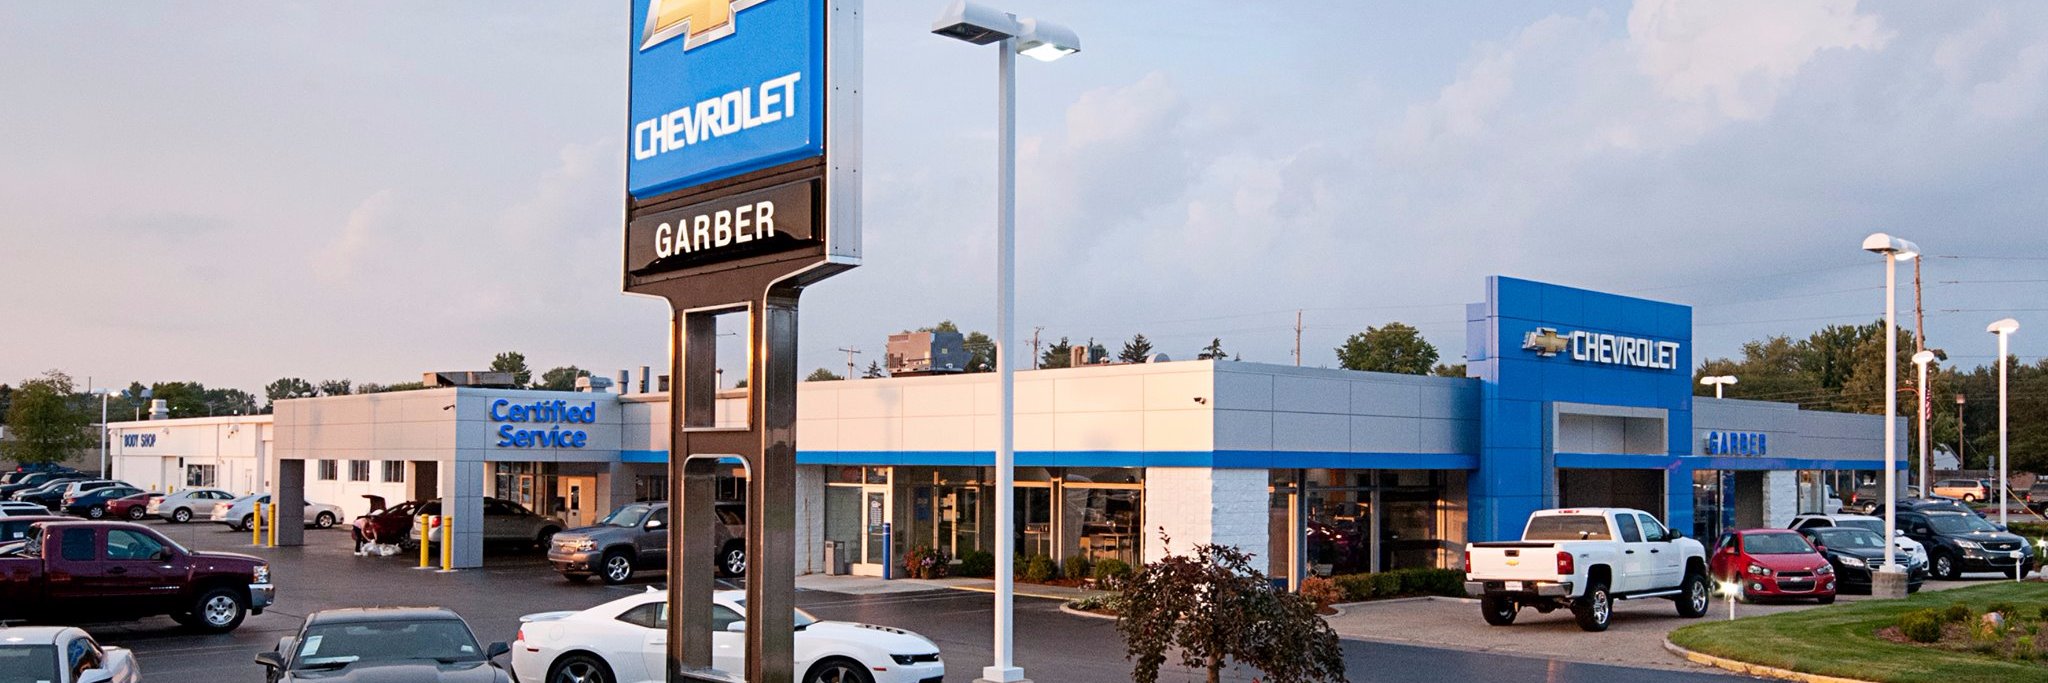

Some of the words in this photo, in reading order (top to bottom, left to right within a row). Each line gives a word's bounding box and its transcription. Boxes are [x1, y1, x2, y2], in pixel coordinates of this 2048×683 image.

[634, 71, 801, 160] CHEVROLET
[655, 201, 774, 259] GARBER
[1572, 330, 1680, 370] CHEVROLET
[491, 399, 596, 423] Certified
[124, 433, 139, 447] BODY
[141, 433, 156, 447] SHOP
[498, 424, 587, 447] Service
[1709, 431, 1766, 455] GARBER
